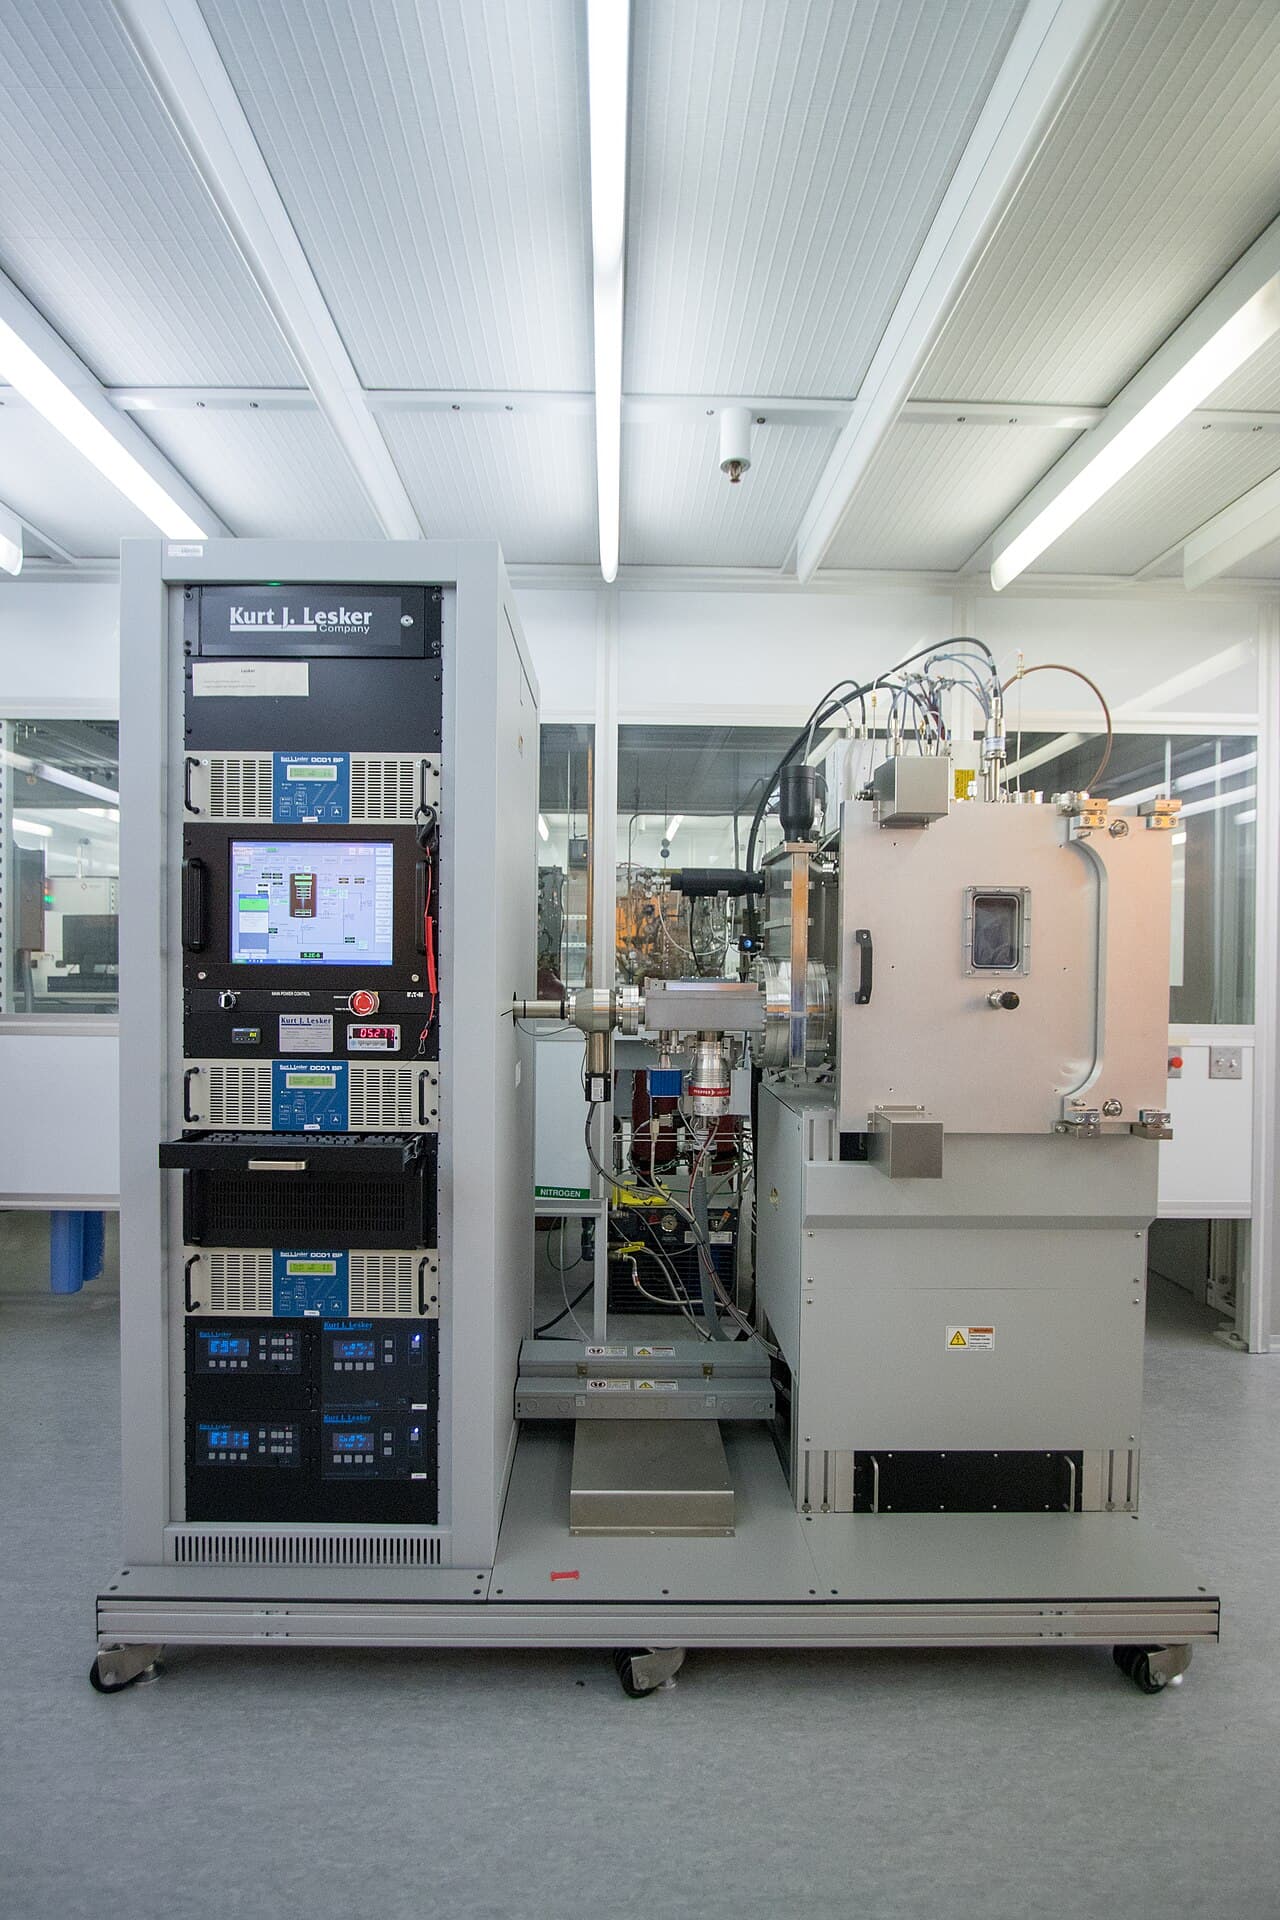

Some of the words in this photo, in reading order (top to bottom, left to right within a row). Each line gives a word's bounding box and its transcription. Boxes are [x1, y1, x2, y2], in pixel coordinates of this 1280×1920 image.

[230, 607, 275, 625] Kurt
[281, 607, 296, 628] J.
[303, 607, 372, 625] Lesker
[319, 624, 370, 634] Company
[540, 1188, 581, 1198] NITROGEN
